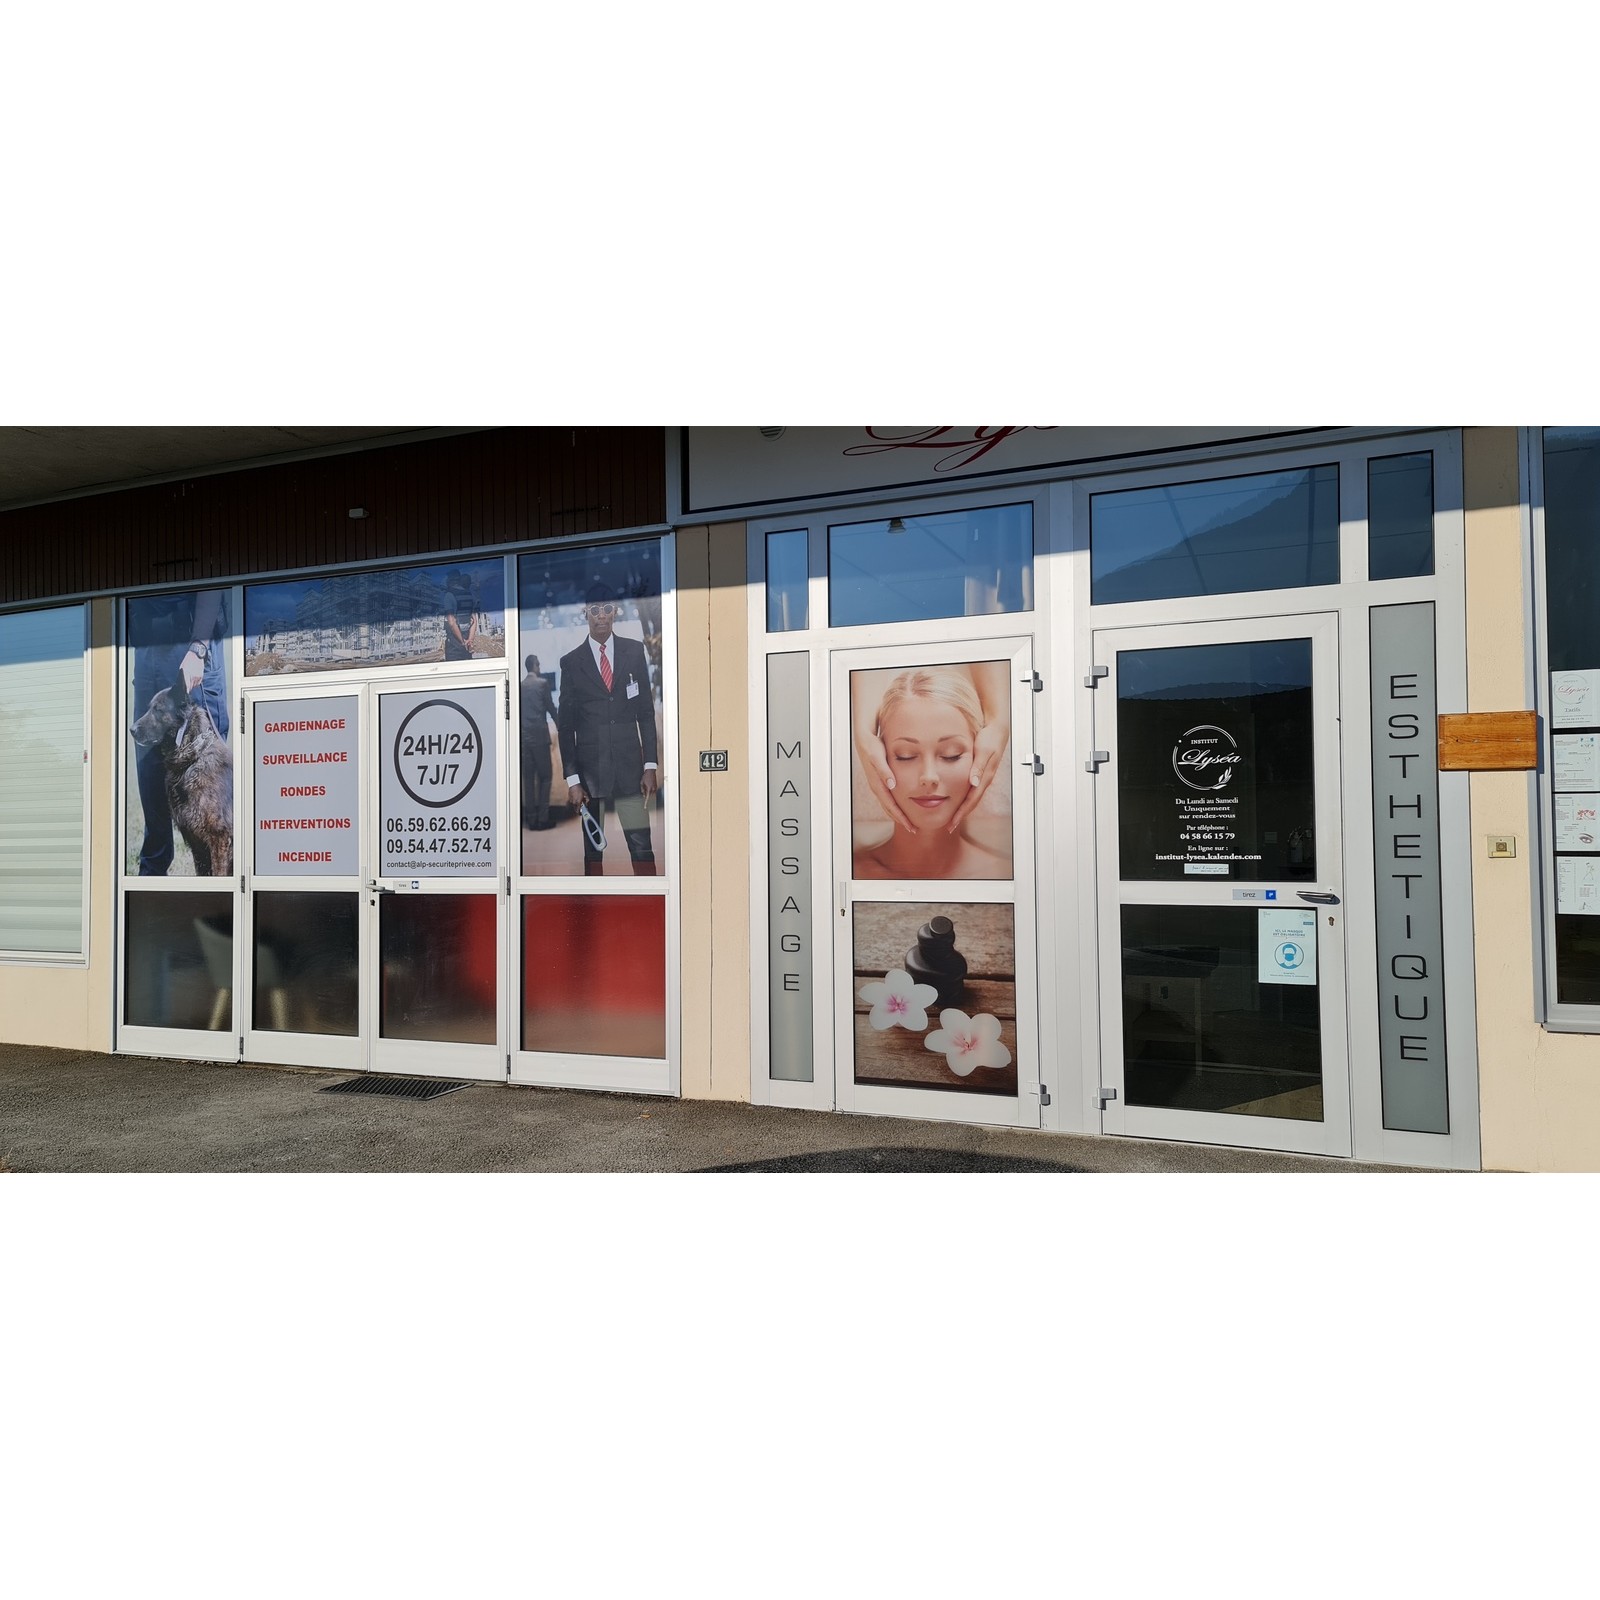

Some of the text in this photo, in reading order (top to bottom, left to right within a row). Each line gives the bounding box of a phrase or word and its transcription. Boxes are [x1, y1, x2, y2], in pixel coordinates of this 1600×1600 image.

[265, 719, 345, 732] GARDIENNAGE
[403, 732, 474, 756] 24H/24
[263, 752, 347, 765] SURVEILLANCE
[703, 753, 724, 768] 412
[1178, 748, 1242, 771] Lyséa
[418, 764, 459, 785] 7J/7
[281, 786, 325, 796] RONDES
[260, 818, 350, 830] INTERVENTIONS
[387, 816, 491, 832] 06.59.62.66.29
[387, 838, 491, 853] 09.54.47.52.74
[279, 852, 331, 861] INCENDIE
[1156, 853, 1261, 861] institut-lysea.kalendes.com
[387, 861, 491, 869] contact@alp-securiteprivee.com
[777, 742, 801, 991] MASSAGE
[1388, 674, 1429, 1062] ESTHETIQUE
